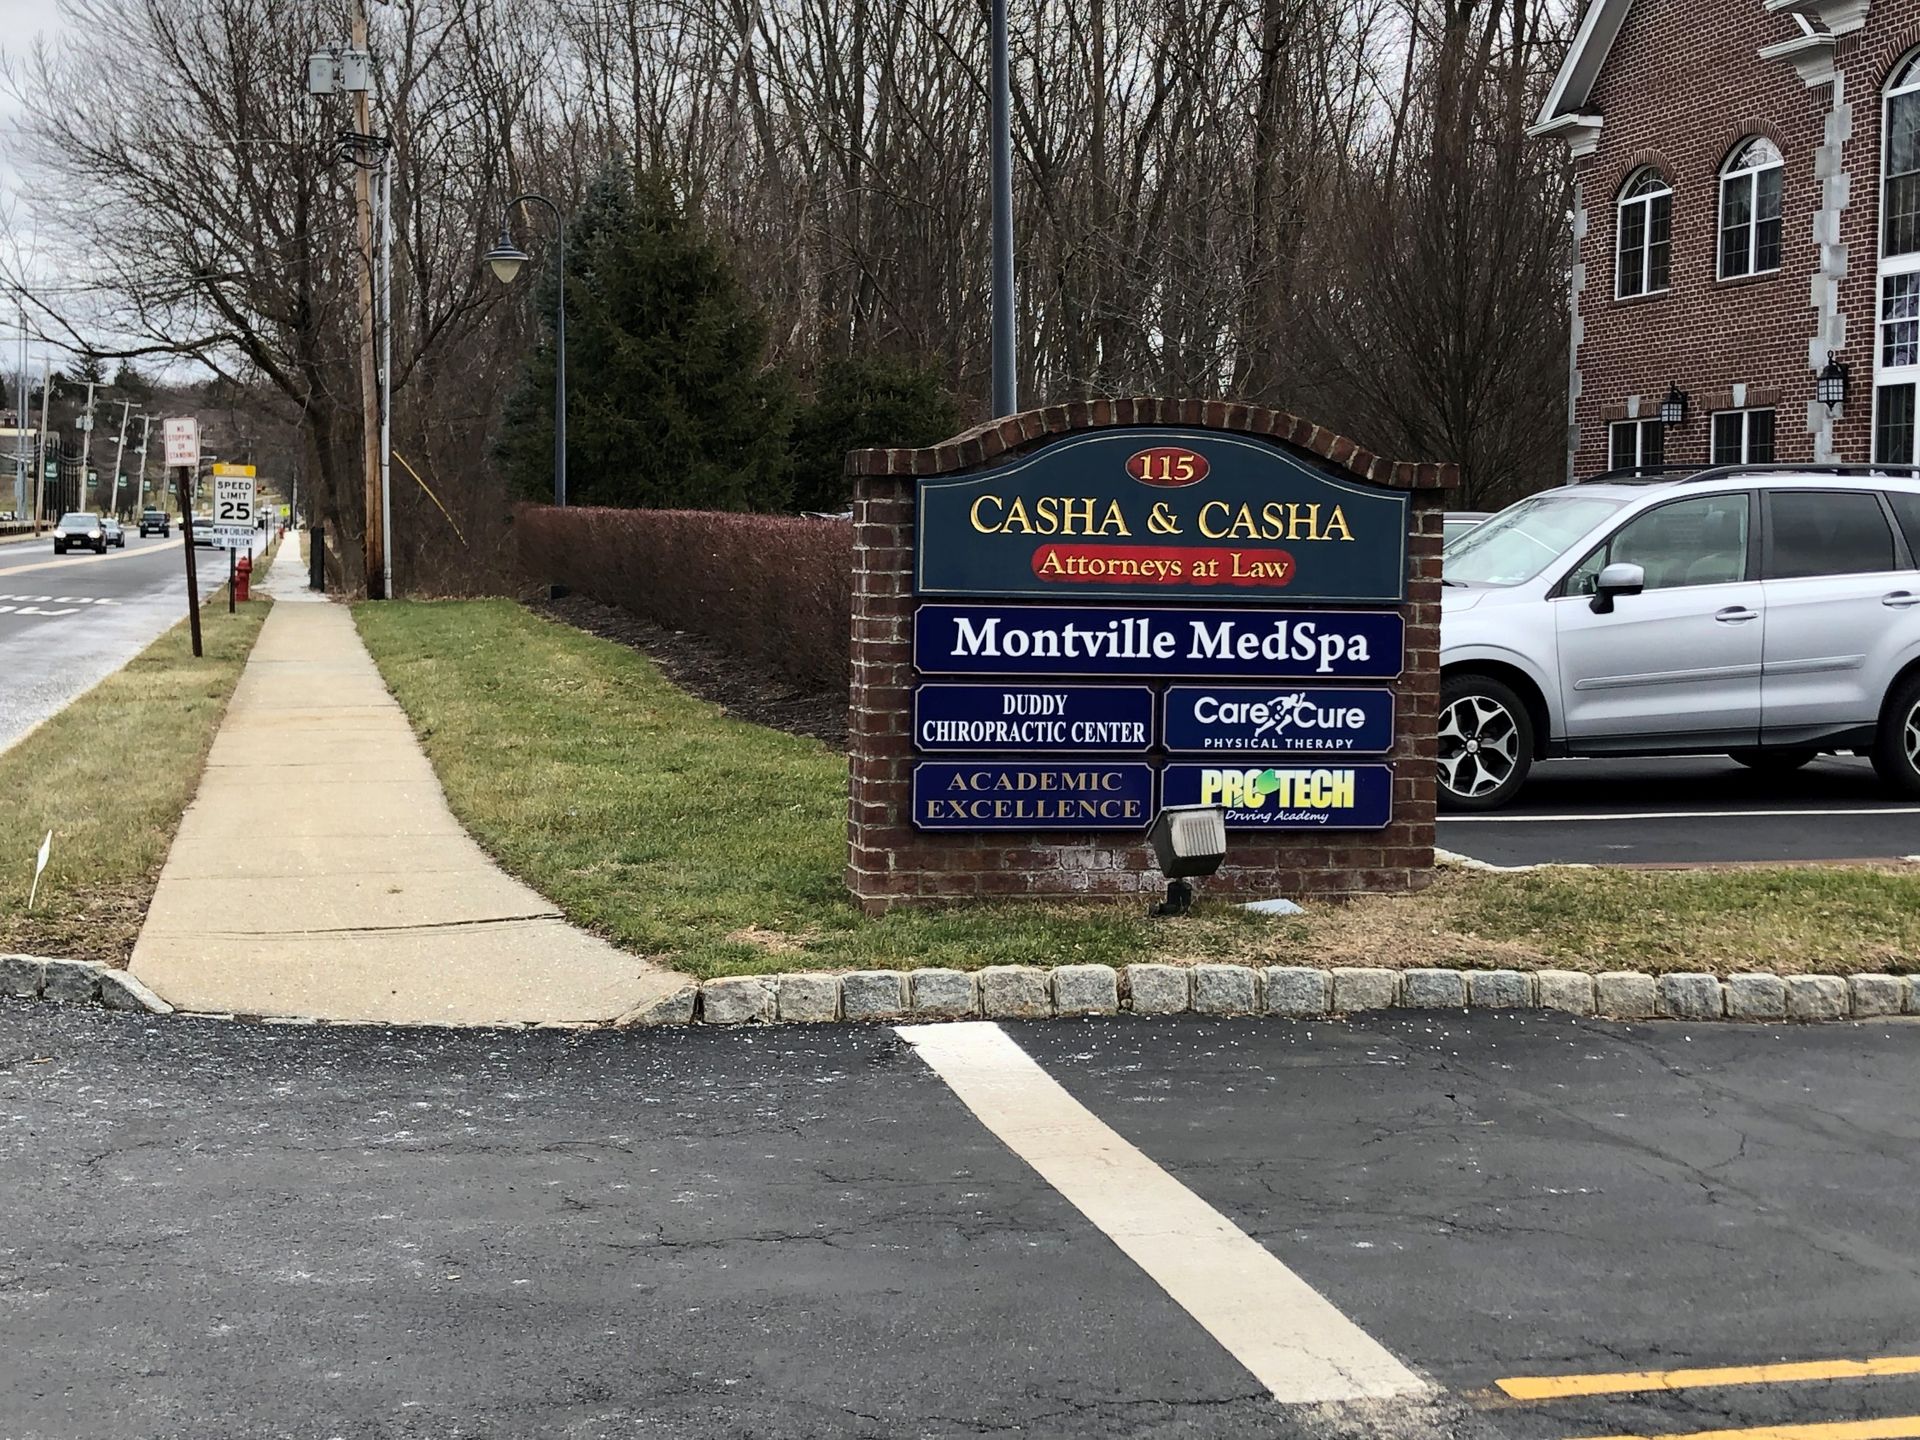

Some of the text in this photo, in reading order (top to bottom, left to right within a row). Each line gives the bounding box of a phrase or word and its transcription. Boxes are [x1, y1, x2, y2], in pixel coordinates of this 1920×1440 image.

[168, 433, 194, 442] STOPPING
[168, 451, 196, 459] STANDING
[1139, 454, 1196, 481] 115
[217, 481, 252, 491] SPEED
[220, 492, 248, 500] LIMIT
[220, 501, 251, 521] 25
[970, 495, 1356, 541] CASHA & CASHA
[213, 527, 255, 537] WHEN CHILDREN
[213, 537, 253, 546] ARE PRESENT
[1039, 548, 1289, 582] Attorneys at Law
[950, 617, 1371, 672] Montville MedSpa
[1002, 694, 1068, 715] DUDDY
[1194, 696, 1270, 724] Care
[1292, 701, 1366, 728] Cure
[922, 720, 1146, 743] CHIROPRACTIC CENTER
[1204, 738, 1354, 749] PHYSICAL THERAPY
[947, 772, 1123, 791] ACADEMIC
[1274, 769, 1355, 809] TECH
[926, 800, 1142, 819] EXCELLENCE
[1225, 809, 1330, 823] Driving Academy
